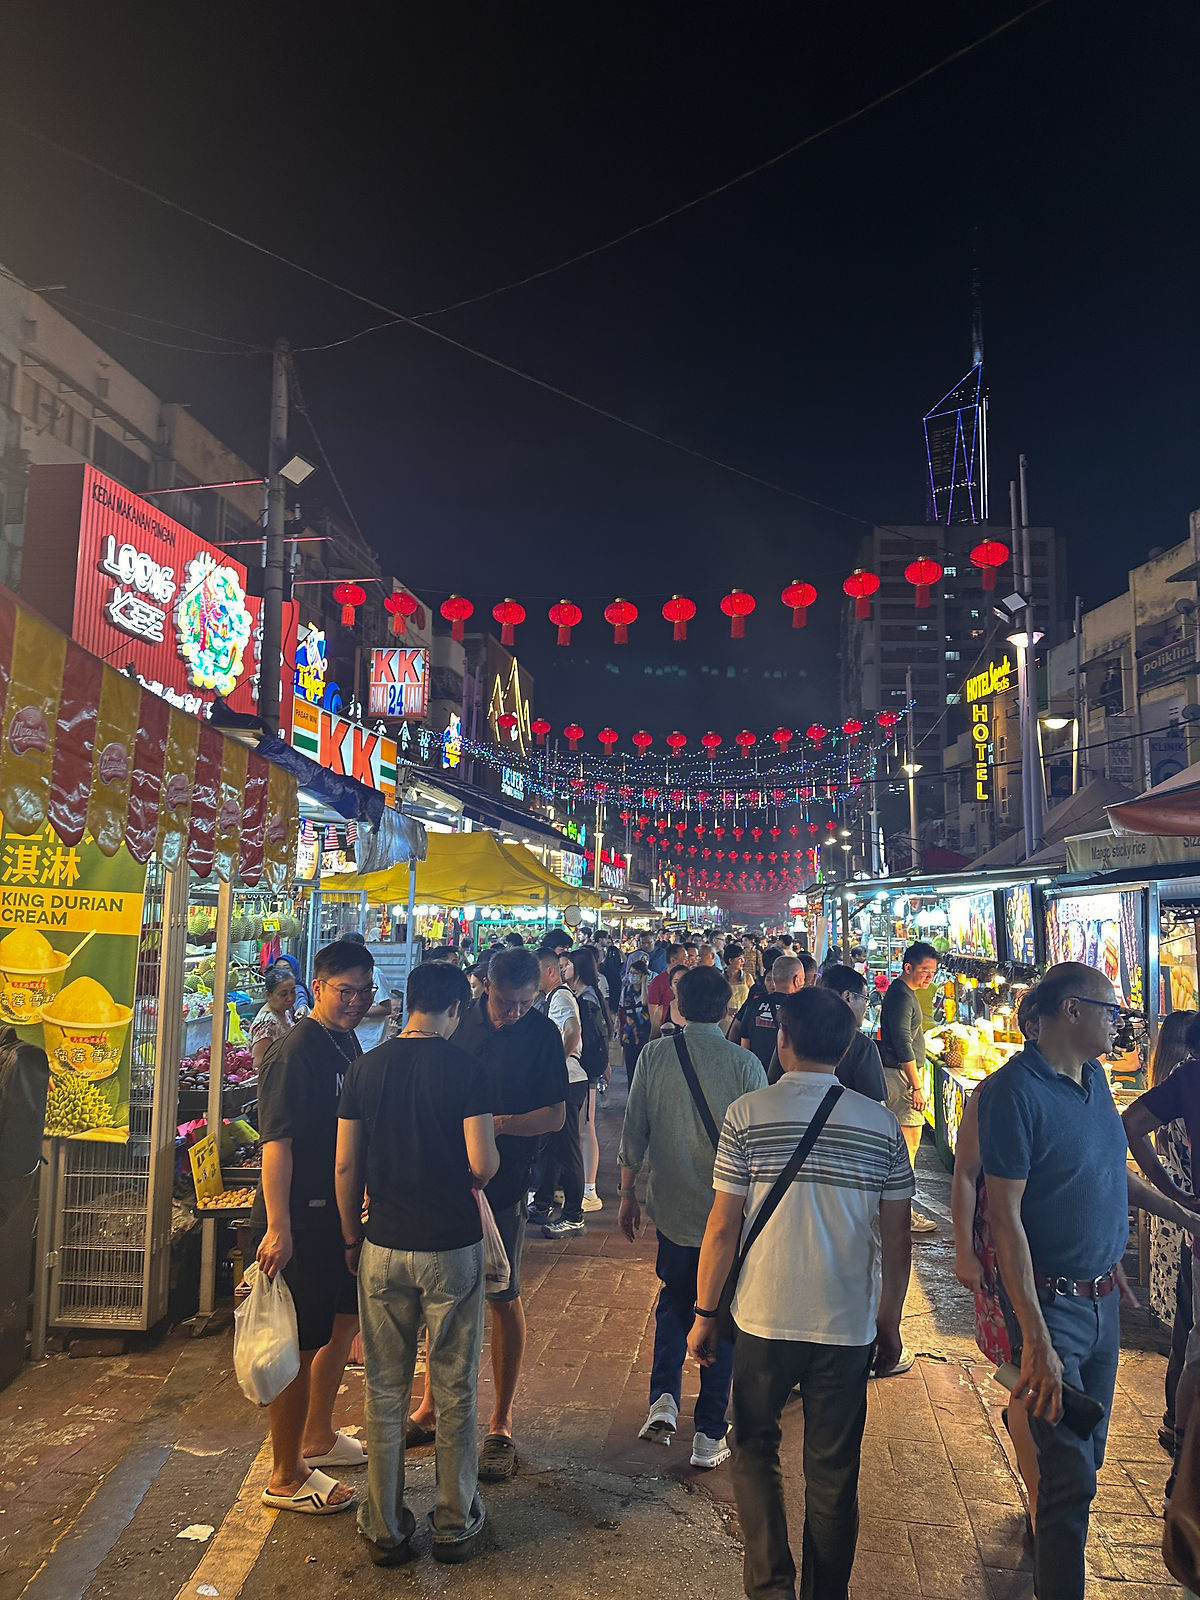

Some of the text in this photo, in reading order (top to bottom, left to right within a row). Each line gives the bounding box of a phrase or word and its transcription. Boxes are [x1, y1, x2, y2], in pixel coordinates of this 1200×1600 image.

[92, 482, 116, 511] KEDAI
[116, 497, 152, 533] MAKANAN
[103, 534, 176, 603] LOONG
[109, 587, 166, 643] KEE
[374, 650, 421, 682] KK
[371, 687, 387, 713] BUKA
[388, 685, 403, 715] 24
[404, 687, 422, 713] JAM
[966, 670, 990, 703] HOTEL
[320, 711, 379, 788] KK
[972, 704, 989, 800] HOTEL
[1091, 846, 1111, 862] Mango
[1132, 840, 1146, 855] rice
[1, 908, 67, 925] CREAM
[2, 892, 123, 912] KING DURIAN
